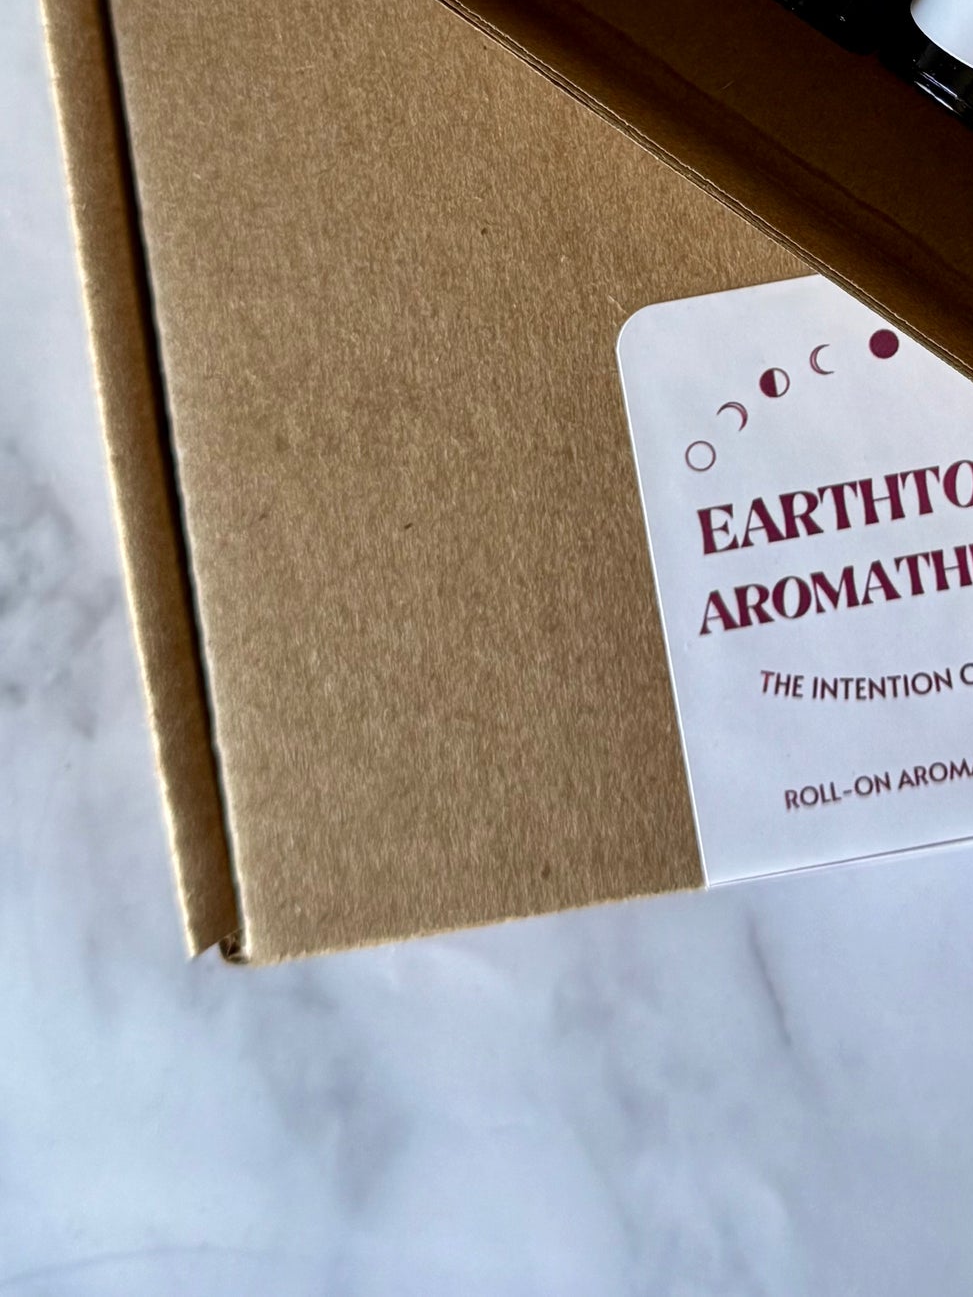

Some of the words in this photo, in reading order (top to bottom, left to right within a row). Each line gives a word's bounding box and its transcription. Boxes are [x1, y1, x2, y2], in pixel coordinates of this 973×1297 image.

[760, 670, 804, 699] THE
[811, 668, 953, 701] INTENTION
[785, 772, 891, 810] ROLL-ON
